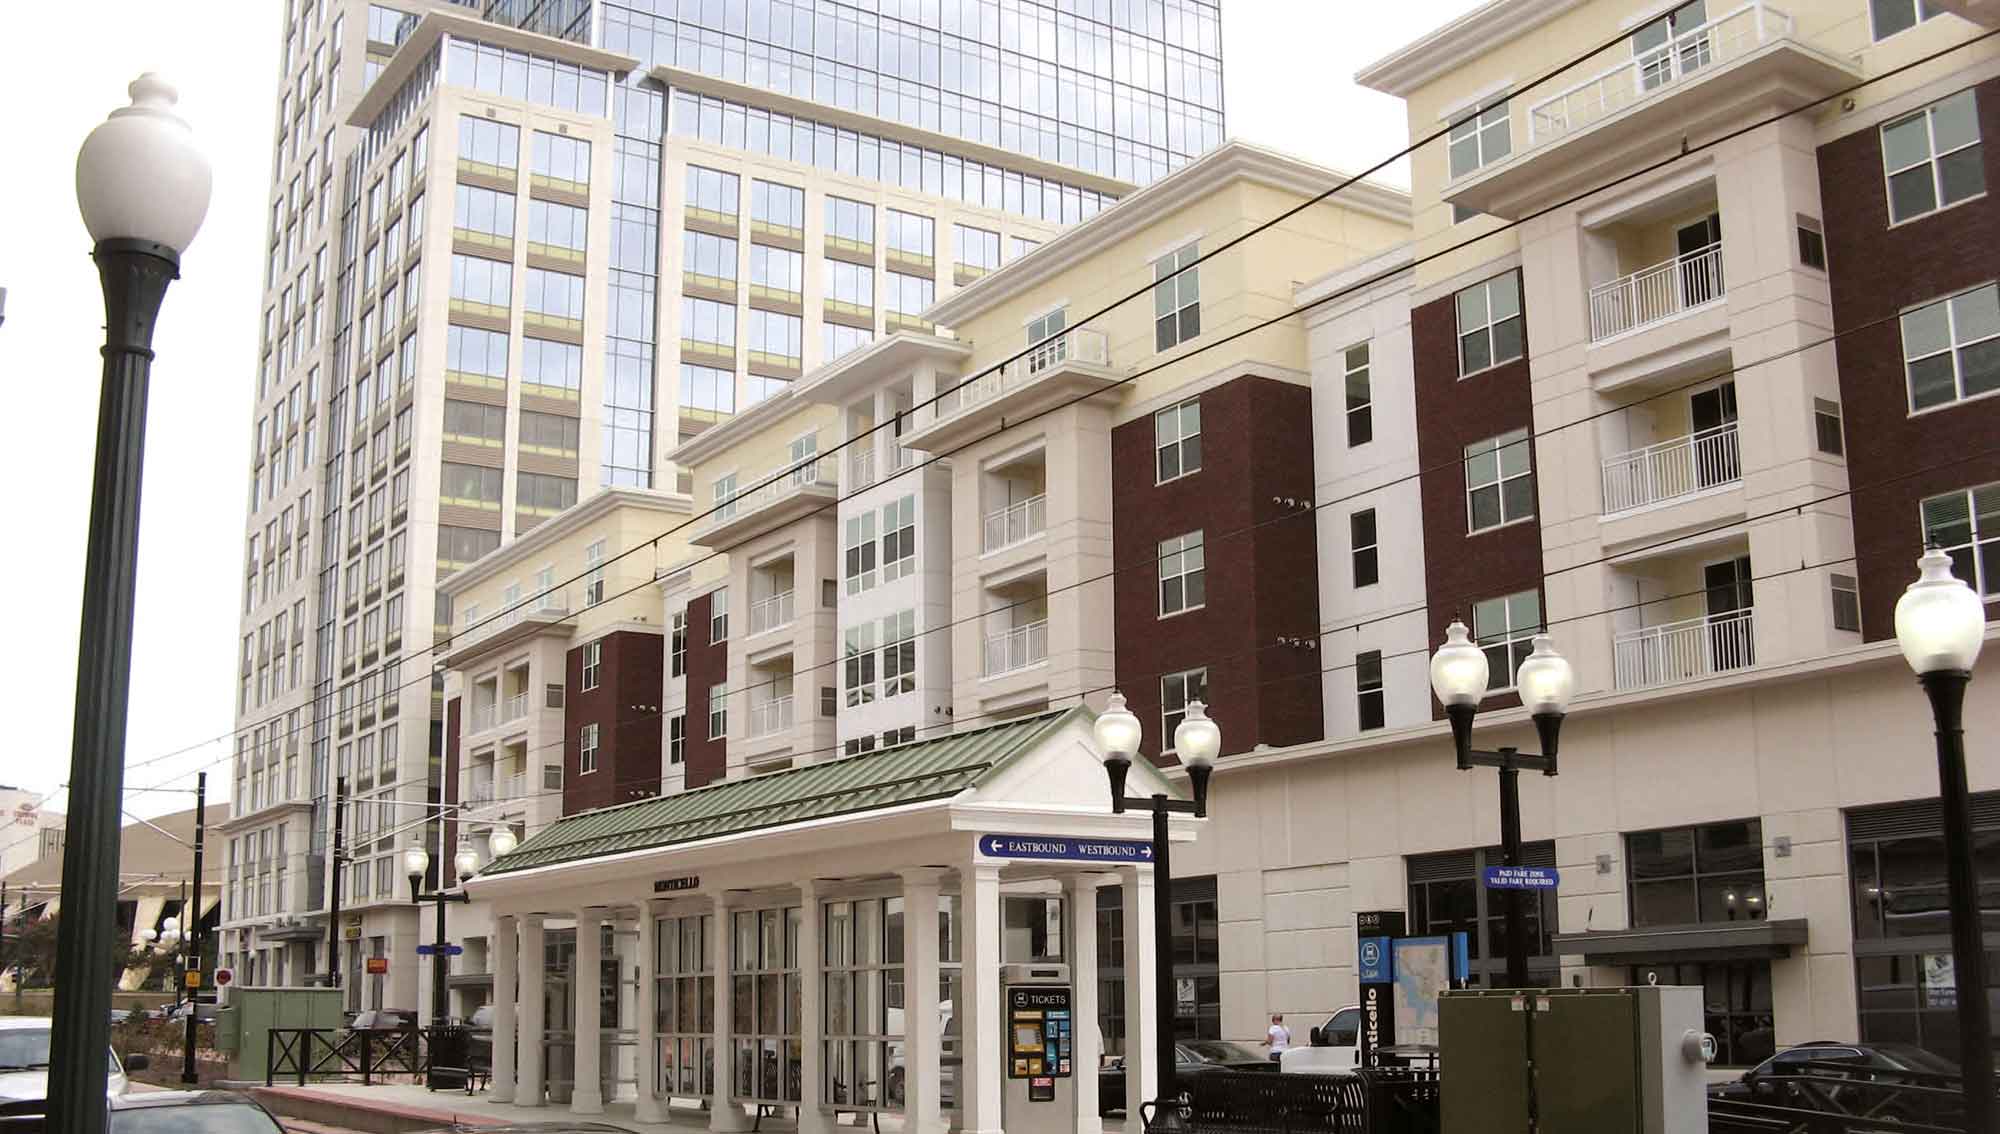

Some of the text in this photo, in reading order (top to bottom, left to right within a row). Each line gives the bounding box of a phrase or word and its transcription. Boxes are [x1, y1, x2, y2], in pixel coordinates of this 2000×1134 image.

[1008, 842, 1137, 856] EASTBOUND WESTBOUND
[1031, 995, 1066, 1005] TICKETS
[1366, 988, 1379, 1068] onticello
